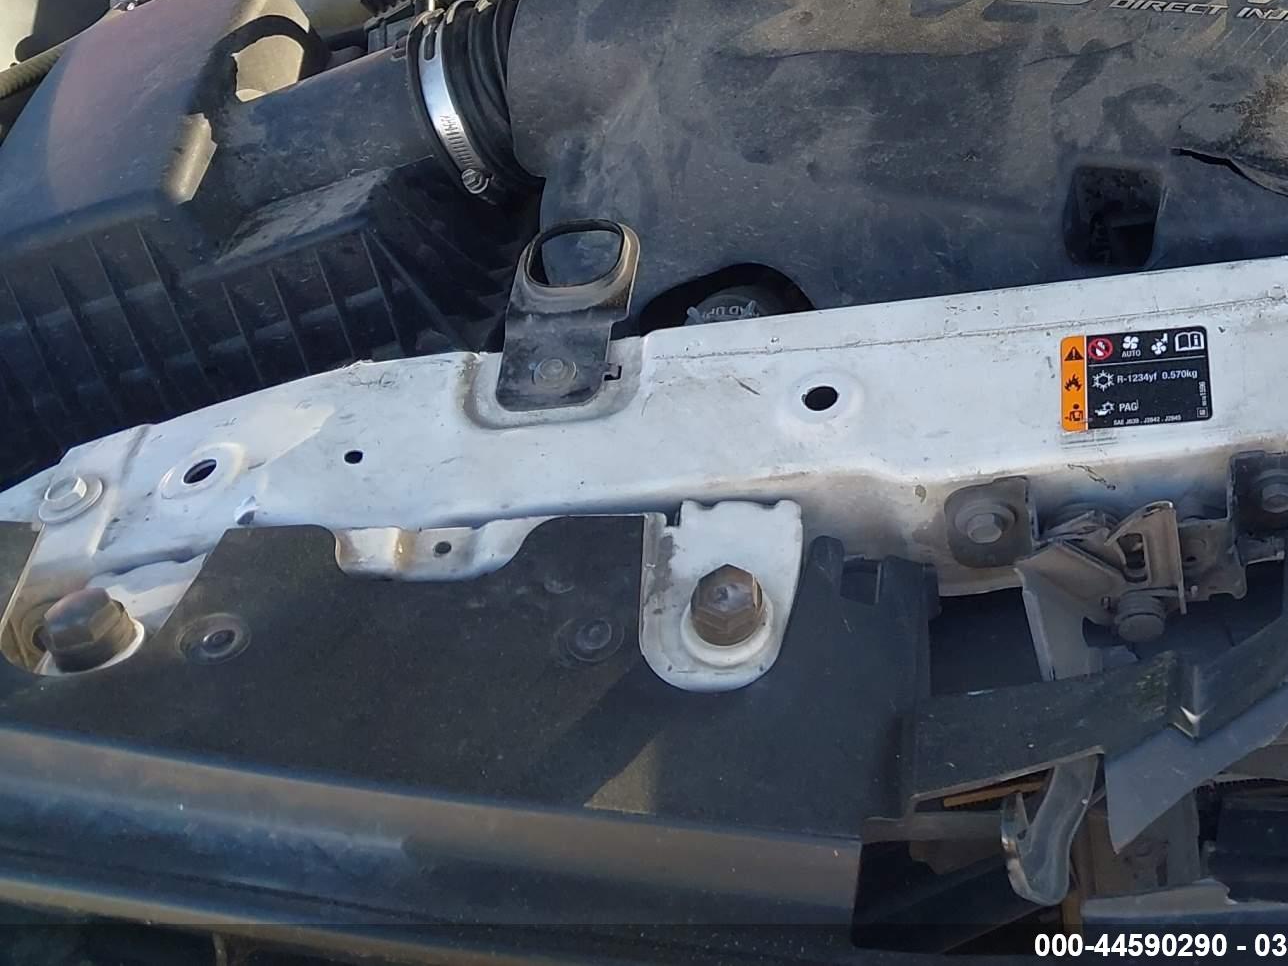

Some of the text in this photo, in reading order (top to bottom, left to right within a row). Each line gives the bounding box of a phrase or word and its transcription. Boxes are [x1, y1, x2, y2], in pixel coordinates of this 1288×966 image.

[1121, 349, 1141, 358] AUTO
[1117, 370, 1198, 384] R-1234yf 0.570kg
